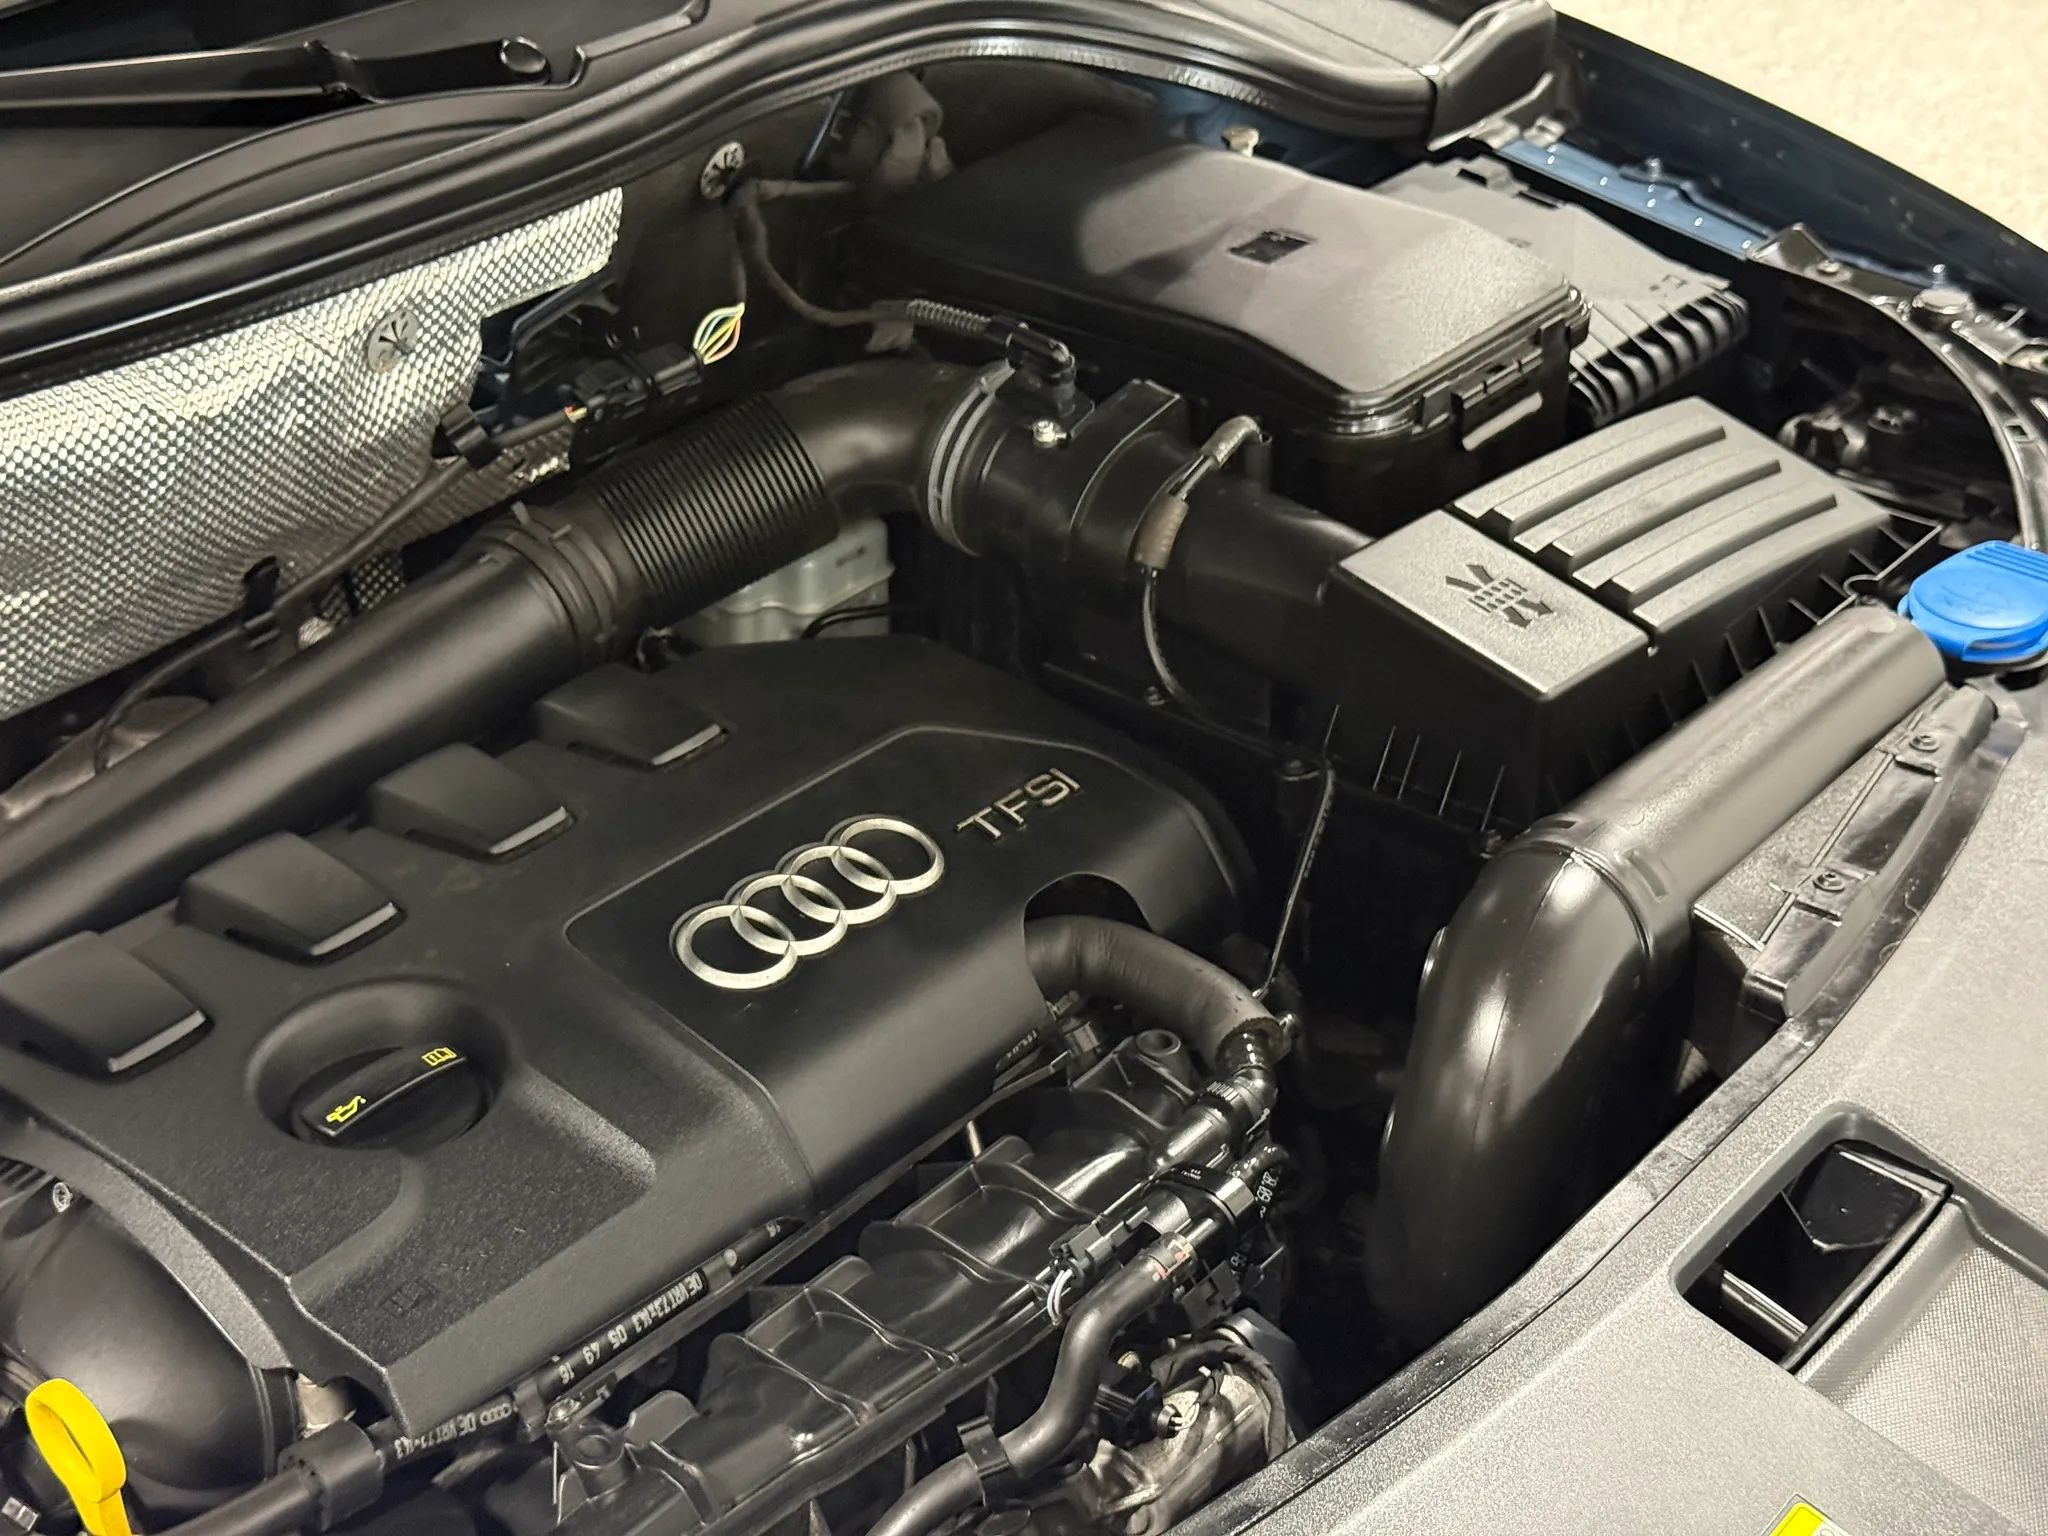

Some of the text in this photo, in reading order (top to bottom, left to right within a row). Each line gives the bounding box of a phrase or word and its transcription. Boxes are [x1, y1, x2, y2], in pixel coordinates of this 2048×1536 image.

[956, 767, 1081, 839] TFSI
[607, 1324, 628, 1350] 05
[559, 1362, 575, 1384] 16
